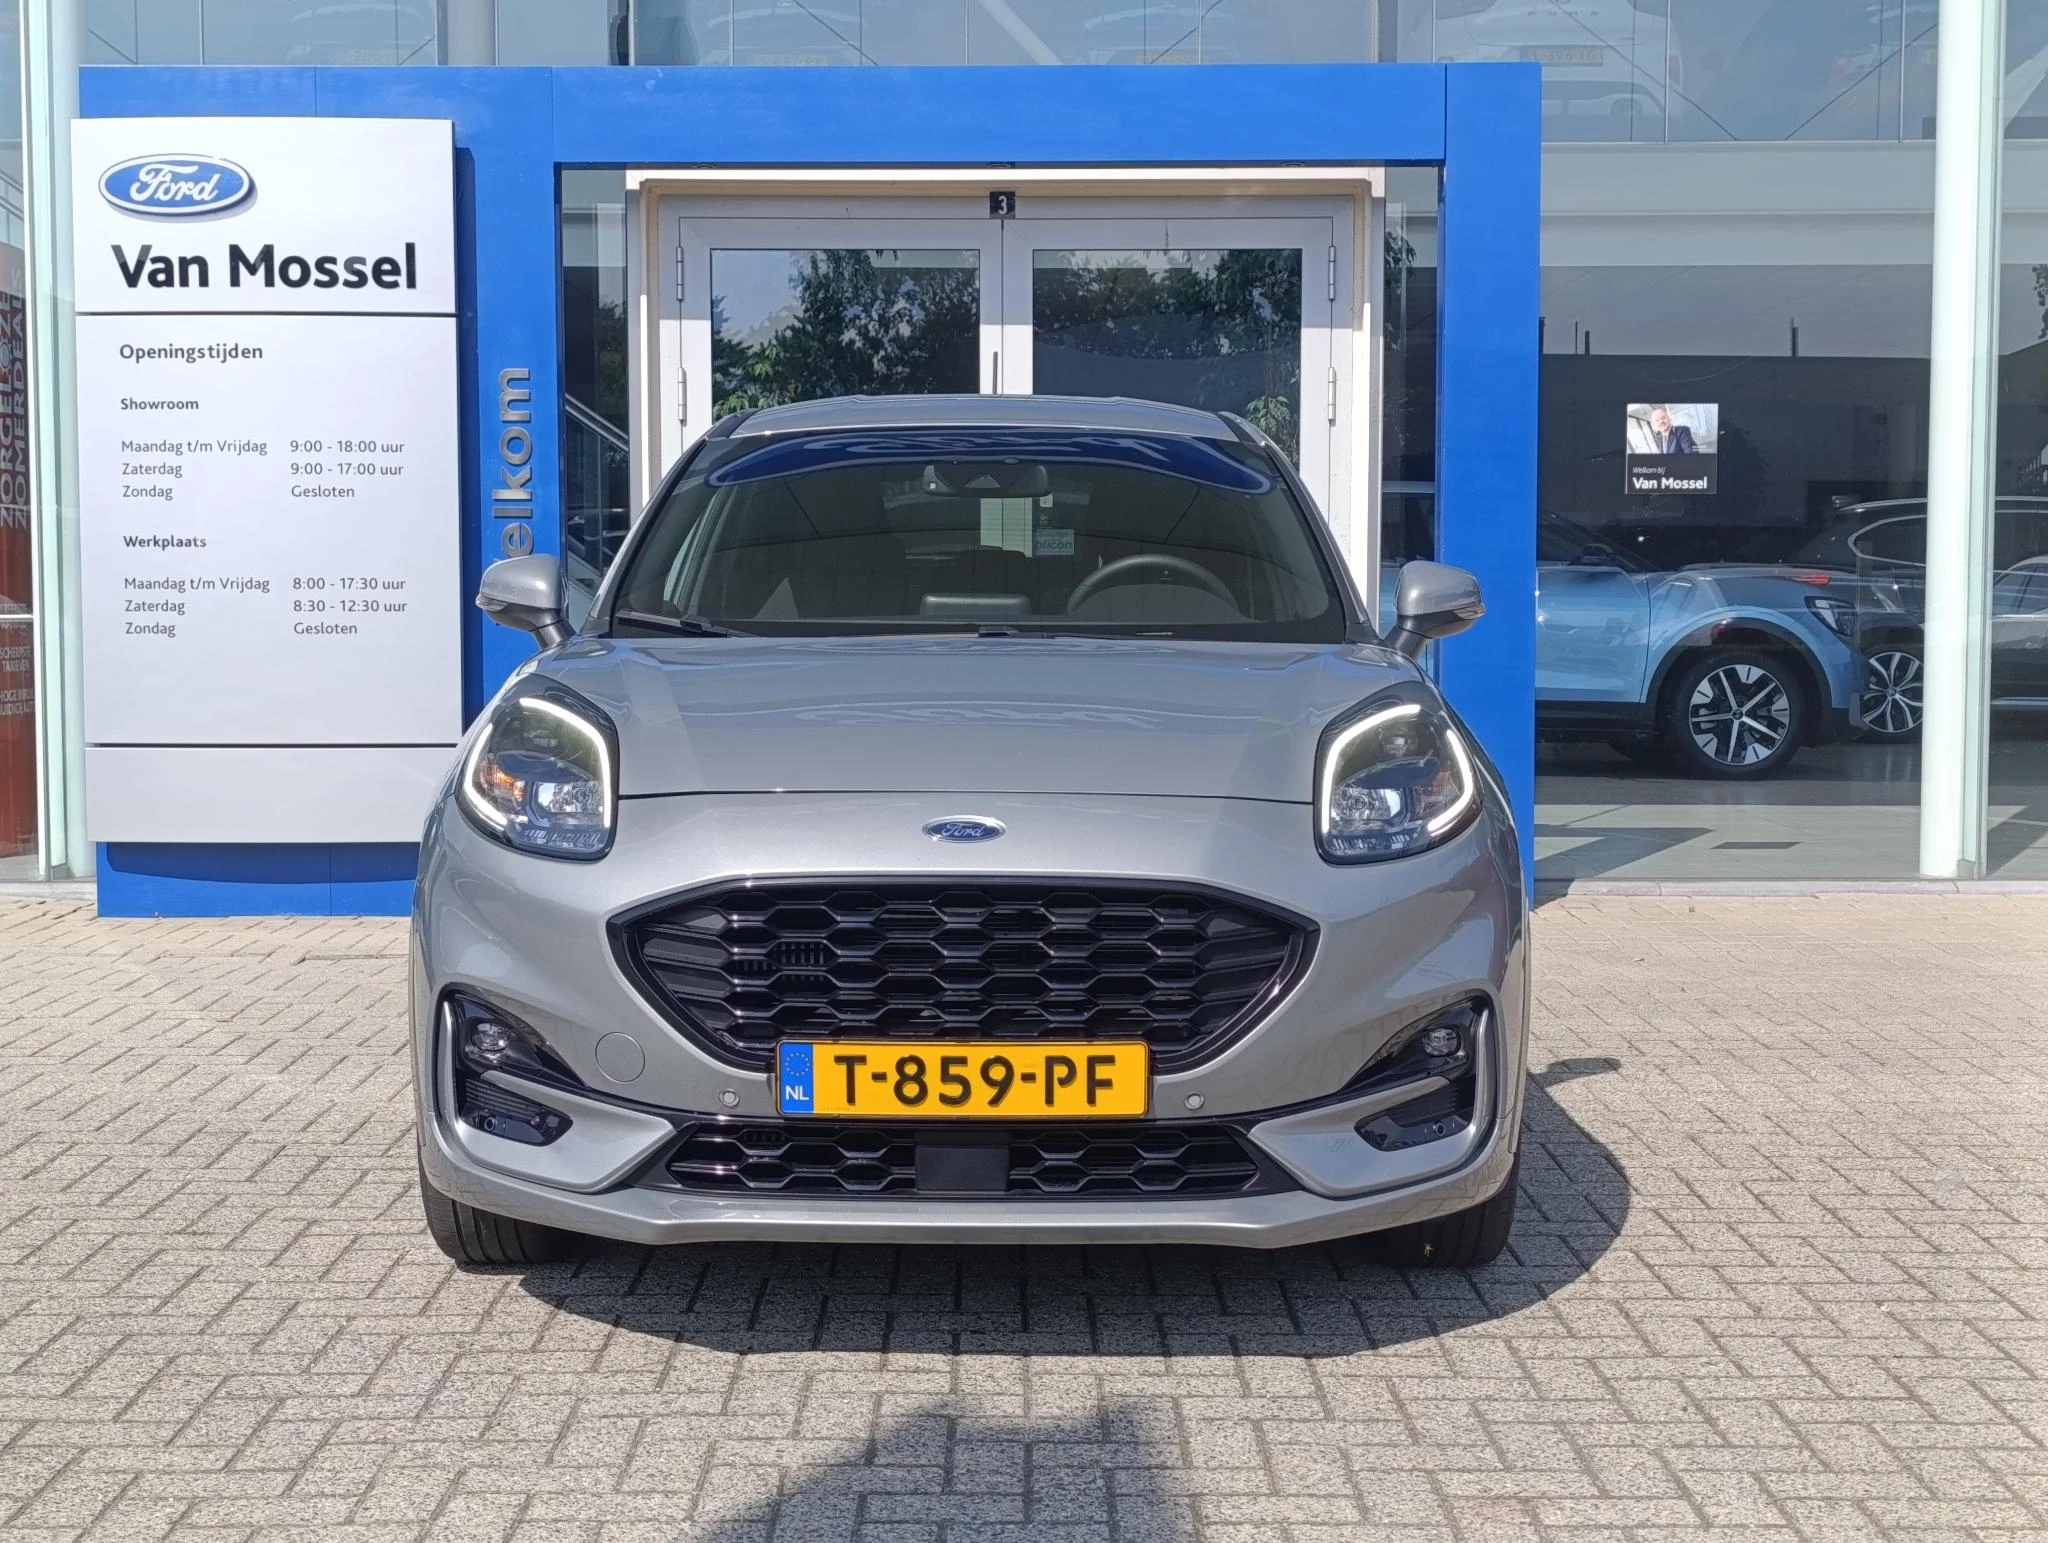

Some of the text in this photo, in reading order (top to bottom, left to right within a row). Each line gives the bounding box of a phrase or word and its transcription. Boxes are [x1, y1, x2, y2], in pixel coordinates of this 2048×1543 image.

[129, 163, 221, 201] Ford
[998, 195, 1007, 215] 3
[110, 241, 417, 290] Van Mossel
[119, 343, 264, 363] Openingstijden
[120, 397, 200, 411] Showroom
[121, 439, 268, 457] Maandag t/m Vrijdag
[290, 440, 323, 454] 9:00
[336, 439, 377, 454] 18:00
[381, 443, 406, 454] uur
[121, 462, 183, 479] Zaterdag
[290, 462, 323, 476] 9:00
[336, 462, 377, 476] 17:00
[380, 465, 405, 476] uur
[491, 367, 534, 562] elkom
[1632, 466, 1666, 476] Welkom bij
[1632, 475, 1708, 490] Van Mossel
[122, 485, 174, 502] Zondag
[291, 484, 356, 499] Gesloten
[123, 534, 207, 551] Werkplaats
[124, 576, 271, 594] Maandag t/m Vrijdag
[292, 577, 326, 591] 8:00
[339, 577, 378, 591] 17:30
[382, 580, 407, 591] uur
[124, 599, 186, 616] Zaterdag
[293, 599, 326, 613] 8:30
[339, 599, 380, 613] 12:30
[384, 602, 408, 613] uur
[125, 622, 176, 639] Zondag
[293, 621, 358, 635] Gesloten
[941, 822, 985, 837] Ford
[833, 1053, 1118, 1108] T-859-PF
[785, 1085, 810, 1101] NL
